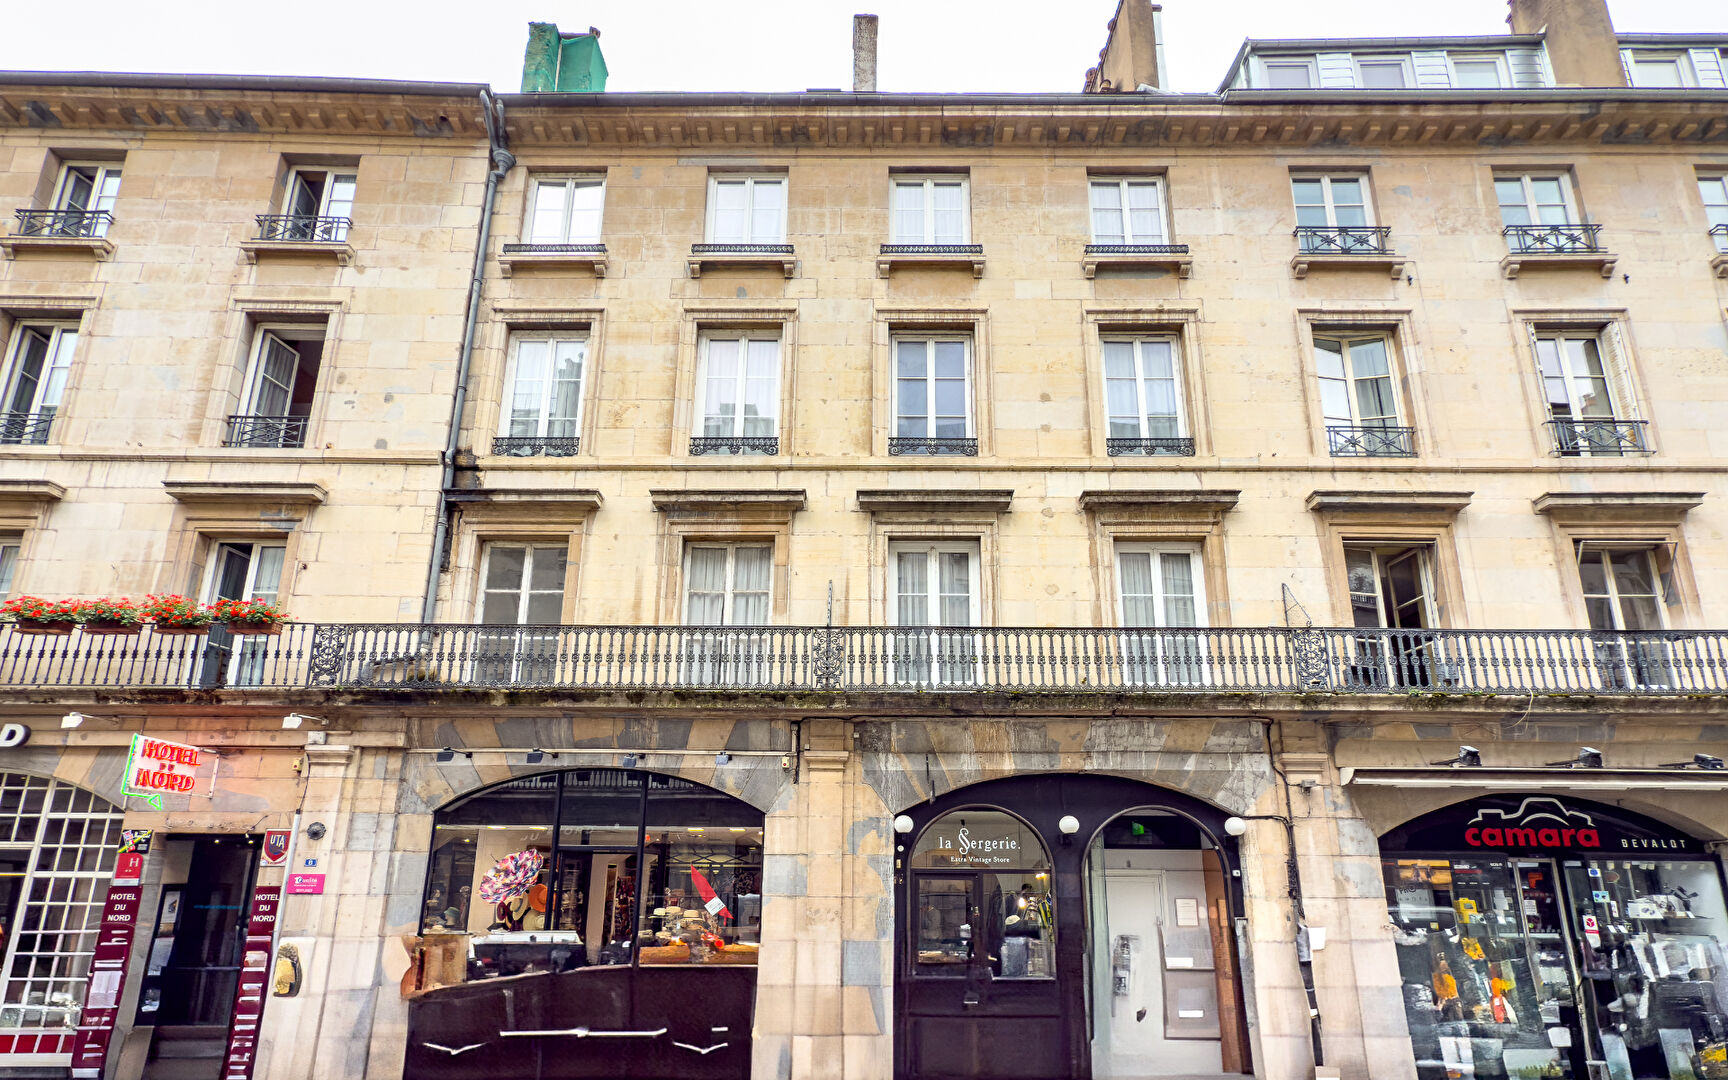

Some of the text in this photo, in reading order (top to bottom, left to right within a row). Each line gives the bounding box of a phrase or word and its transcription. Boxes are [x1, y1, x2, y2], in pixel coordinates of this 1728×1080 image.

[141, 739, 200, 766] HOTEL
[135, 768, 195, 791] NORD
[270, 834, 286, 849] UTA
[938, 837, 952, 849] la
[1465, 827, 1600, 847] camara
[1621, 839, 1686, 849] BEVALOT
[129, 857, 140, 867] H
[968, 855, 992, 864] Vintage
